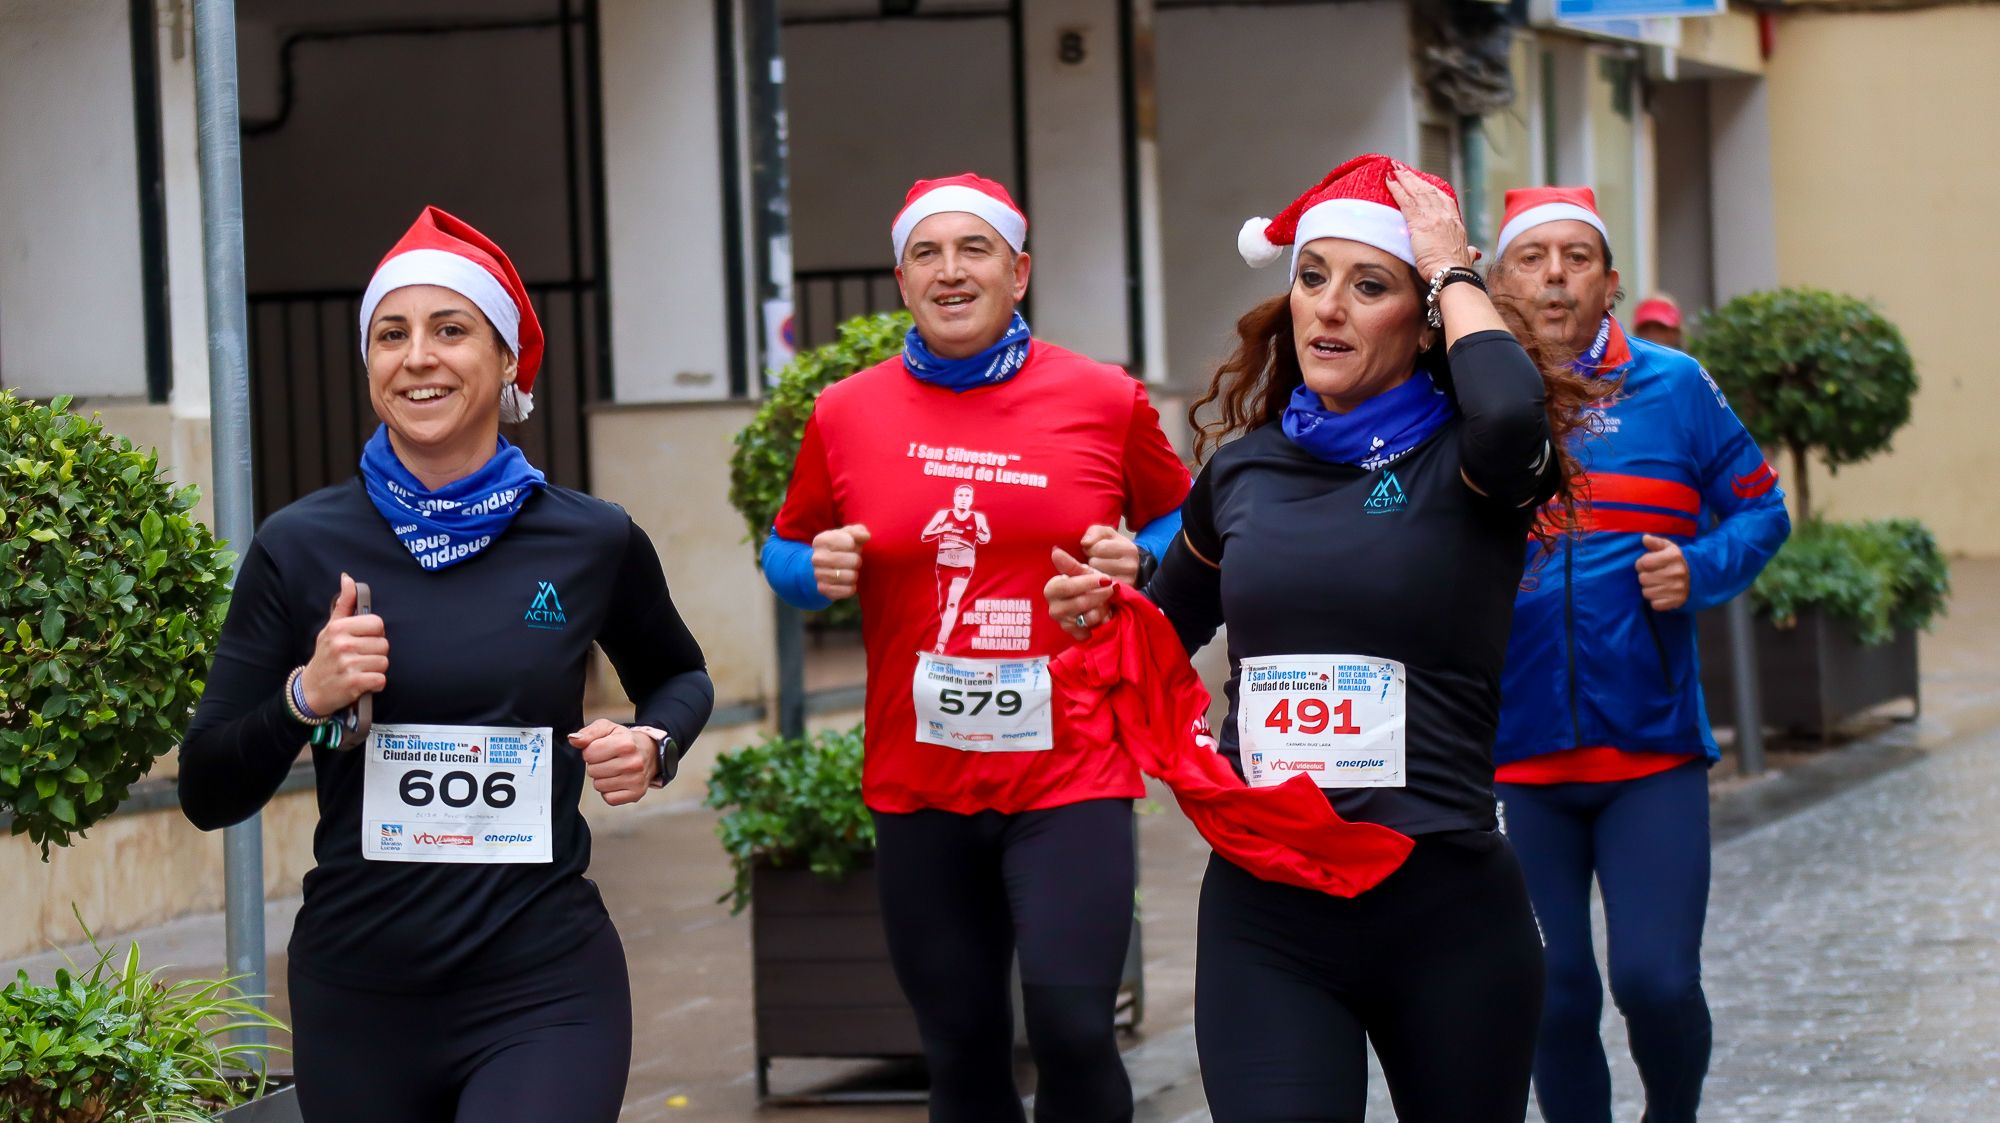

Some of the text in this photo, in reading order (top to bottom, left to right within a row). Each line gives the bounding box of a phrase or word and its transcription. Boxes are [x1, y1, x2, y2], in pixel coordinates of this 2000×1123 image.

[907, 443, 917, 457] I
[917, 444, 944, 461] San
[945, 447, 1007, 466] Silvestre
[923, 461, 1048, 488] Ciudad de Lucena
[1364, 492, 1408, 508] ACTIVA
[974, 599, 1032, 612] MEMORIAL
[524, 609, 567, 624] ACTIVA
[963, 612, 1031, 625] JOSE CARLOS
[979, 625, 1031, 638] HURTADO
[971, 637, 1030, 651] MARJALIZO
[930, 664, 945, 673] San
[946, 665, 976, 678] Silvestre
[1247, 671, 1252, 682] I
[1252, 671, 1266, 682] San
[1266, 670, 1307, 680] Silvestre
[928, 672, 993, 686] Ciudad de Lucena
[1251, 680, 1327, 692] Ciudad de Lucena
[939, 688, 1022, 717] 579
[1264, 698, 1361, 735] 491
[1001, 731, 1038, 739] enerplus
[376, 738, 382, 748] I
[384, 739, 405, 749] San
[407, 740, 456, 751] Silvestre
[383, 750, 479, 763] Ciudad de Lucena
[1336, 758, 1384, 769] enerplus
[398, 769, 517, 809] 606
[484, 834, 533, 844] enerplus
